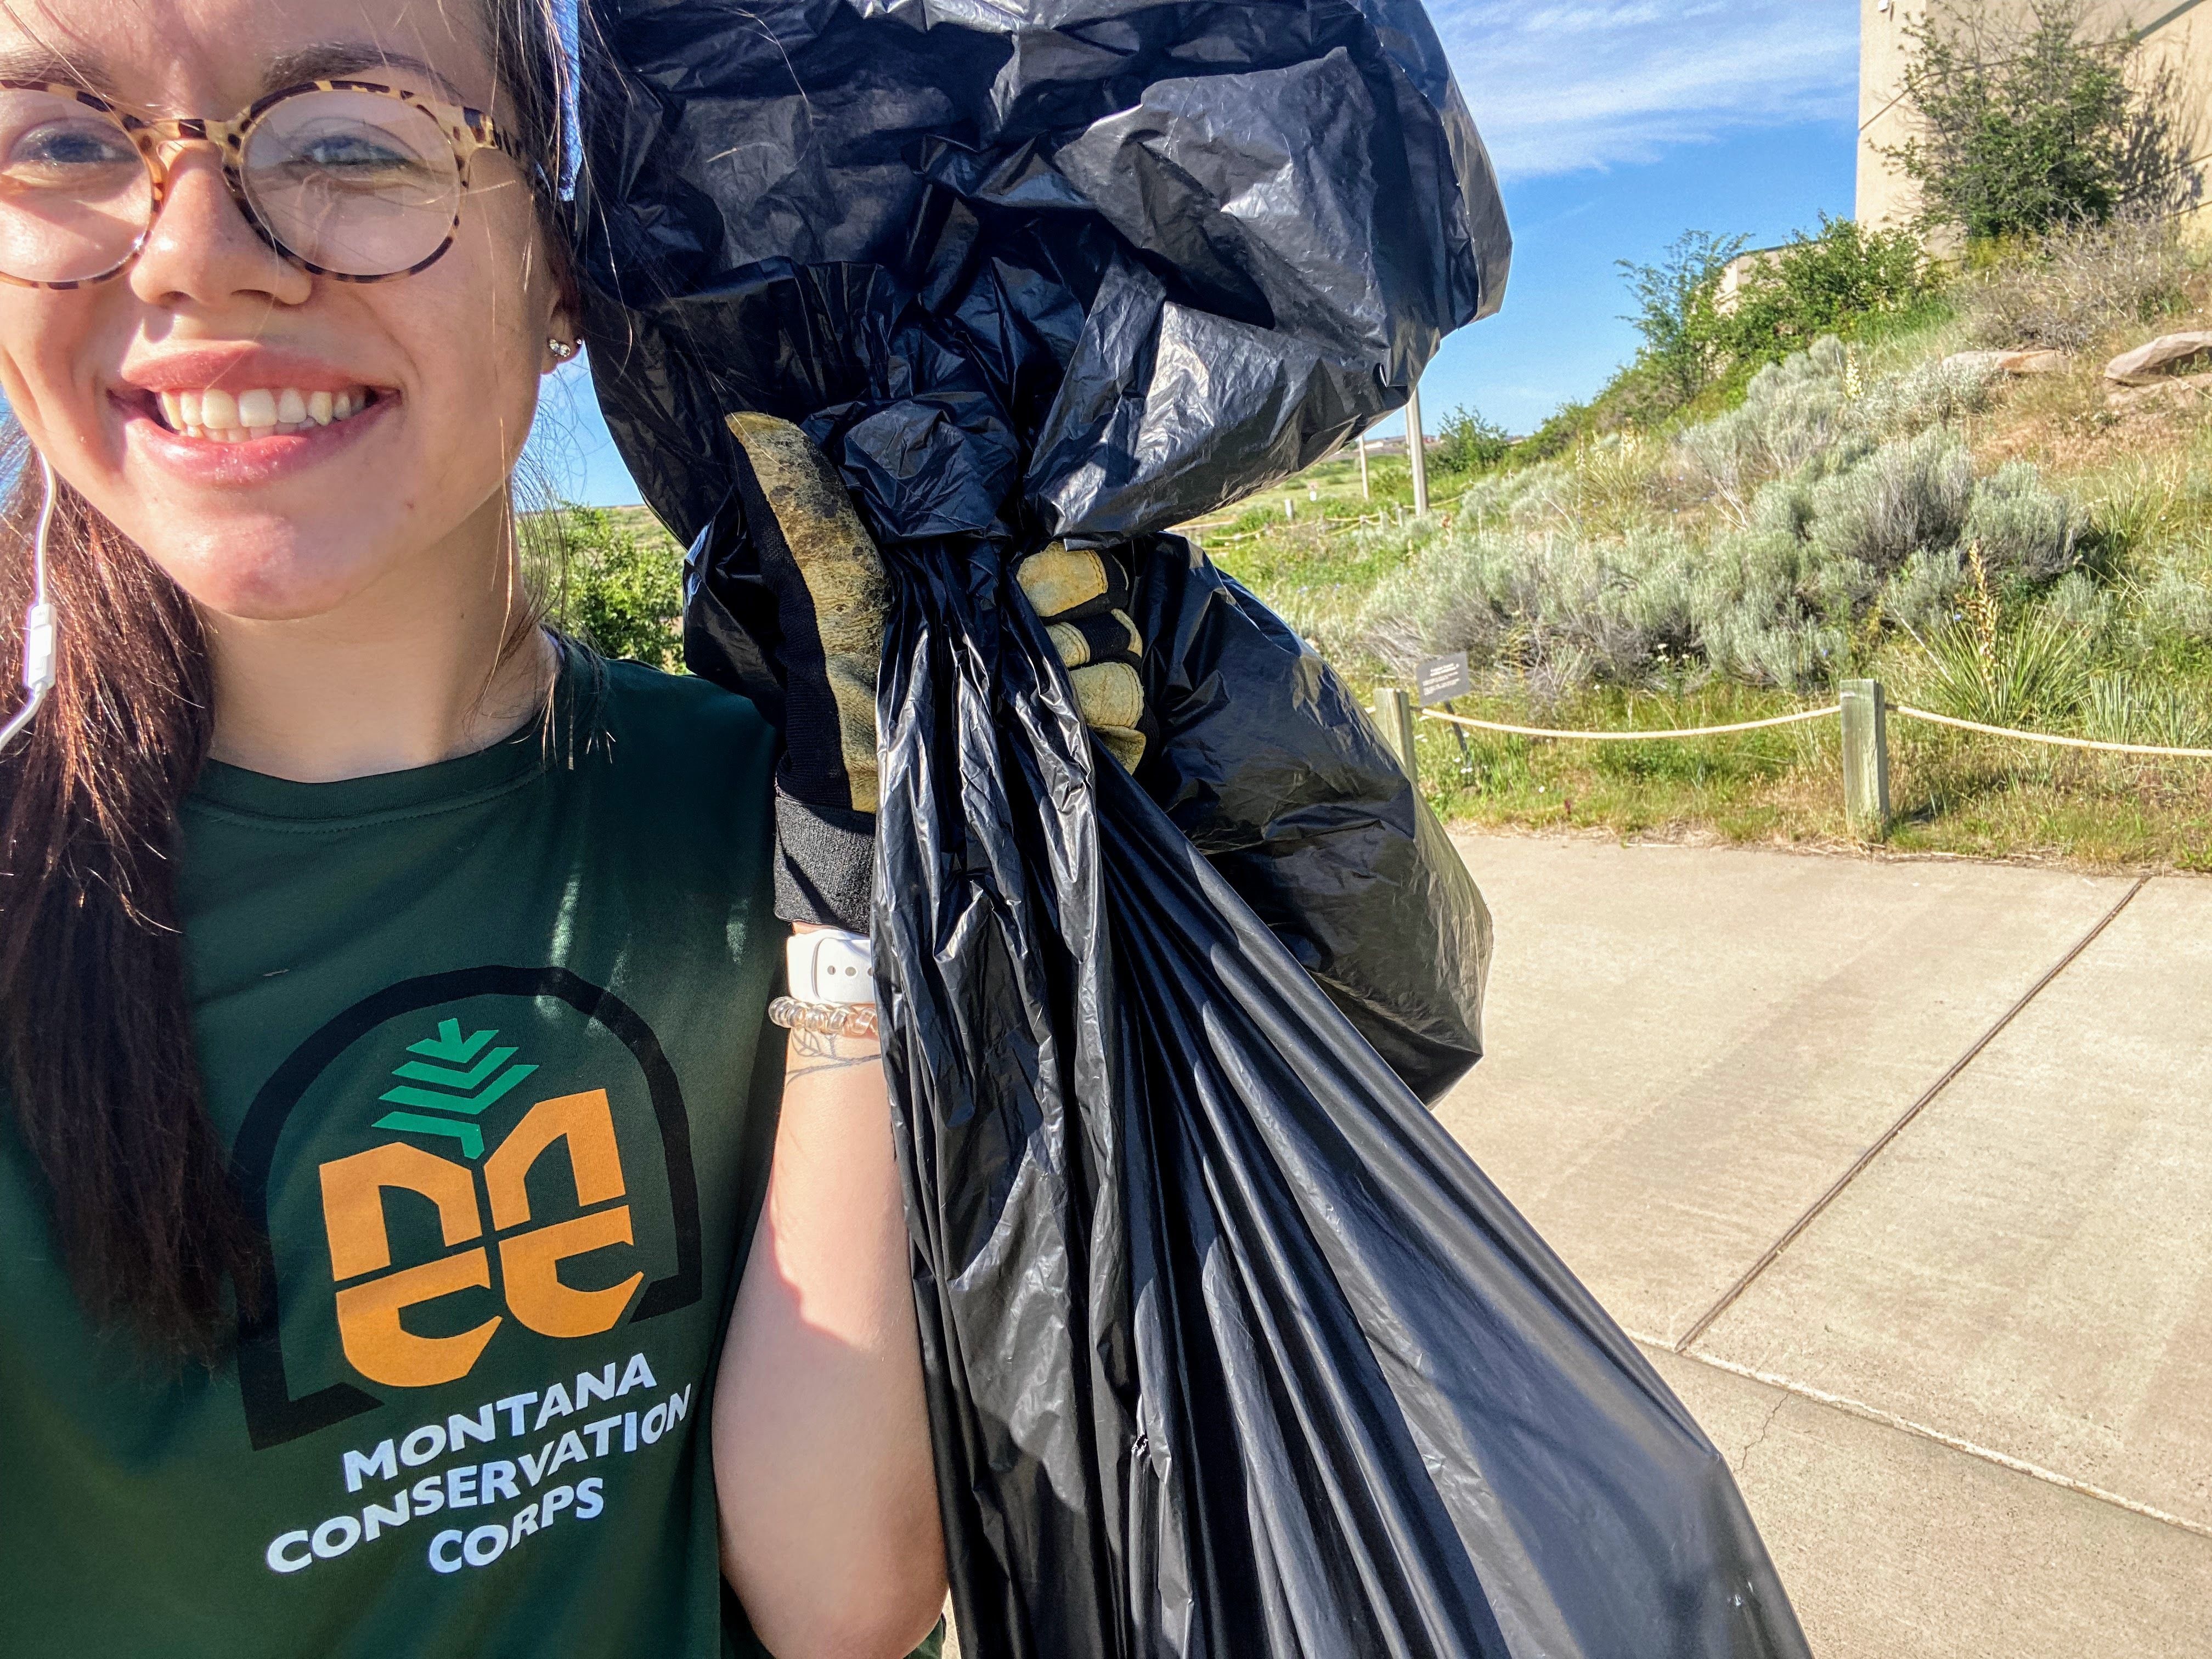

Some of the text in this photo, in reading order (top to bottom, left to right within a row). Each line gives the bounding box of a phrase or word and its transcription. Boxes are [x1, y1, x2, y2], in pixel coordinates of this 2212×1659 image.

[264, 1383, 692, 1574] CONSERVATION
[342, 1352, 657, 1493] MONTANA
[429, 1477, 604, 1573] CORPS
